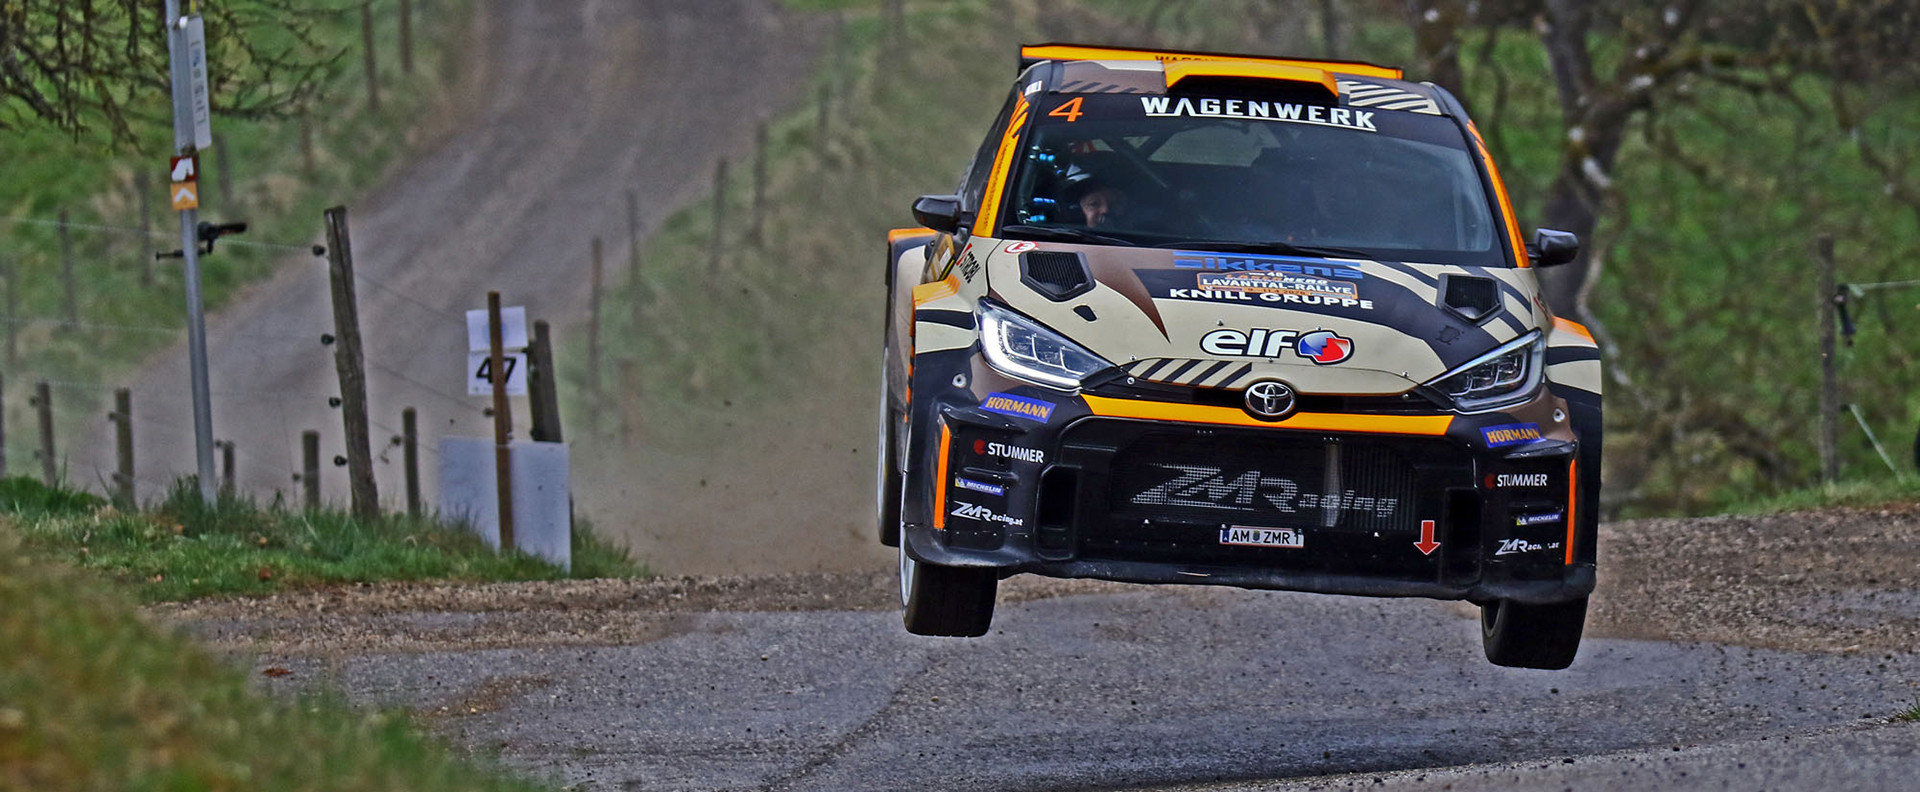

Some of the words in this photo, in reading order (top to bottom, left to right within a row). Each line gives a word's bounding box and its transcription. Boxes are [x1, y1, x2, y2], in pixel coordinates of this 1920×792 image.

[1048, 97, 1084, 122] 4
[1140, 97, 1377, 132] WAGENWERK
[1202, 278, 1353, 295] LAVANTTAL-RALLYE
[1169, 288, 1252, 301] KNILL
[1260, 292, 1374, 310] GRUPPE
[1201, 328, 1299, 357] elf
[476, 356, 516, 384] 47
[987, 442, 1044, 463] STUMMER
[966, 481, 1002, 493] MICHELIN
[1496, 473, 1548, 487] STUMMER
[1527, 514, 1559, 522] MICHELIN
[1231, 529, 1250, 542] AM
[1263, 531, 1291, 544] ZMR
[1294, 533, 1300, 544] 1
